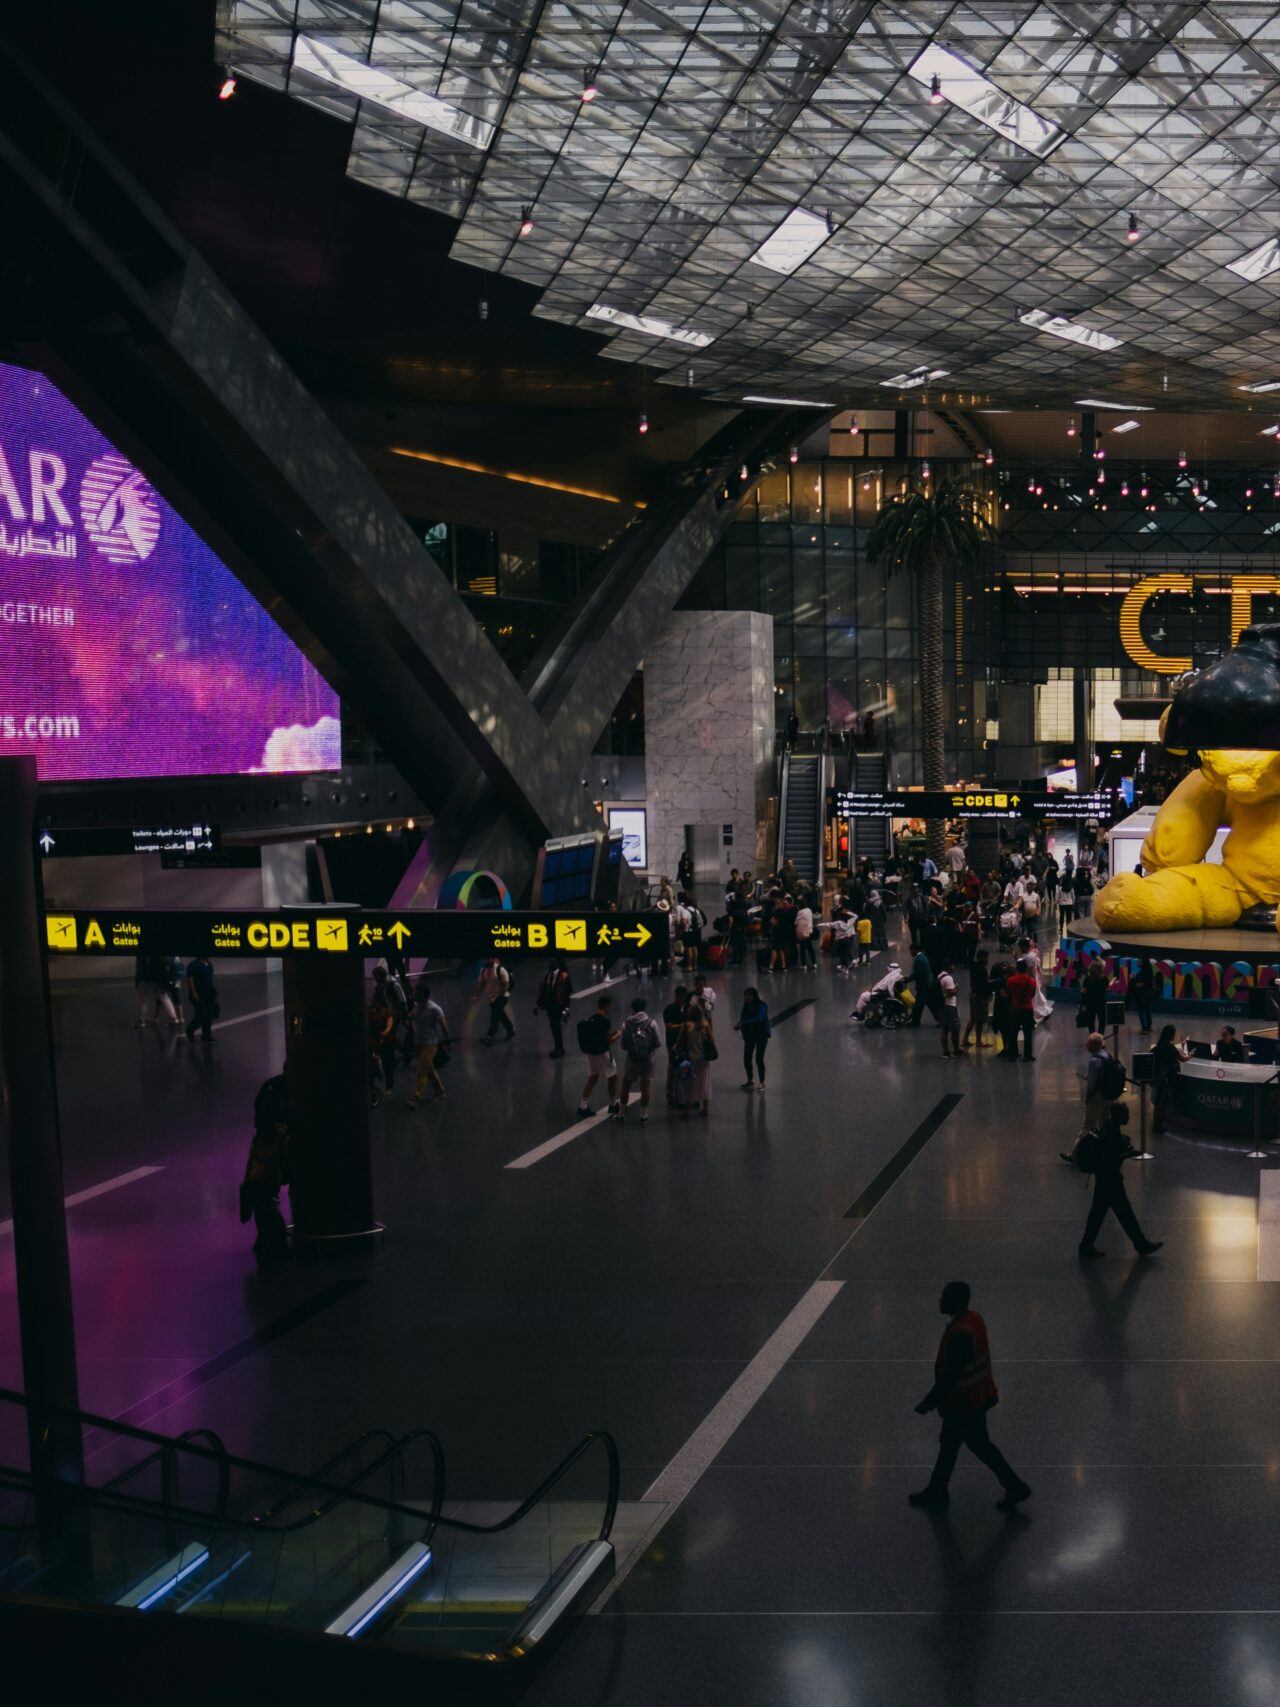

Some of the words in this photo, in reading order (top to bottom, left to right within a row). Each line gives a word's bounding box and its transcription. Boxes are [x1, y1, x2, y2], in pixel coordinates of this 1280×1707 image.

[0, 604, 74, 625] GETHER
[0, 714, 80, 737] s.com
[965, 795, 993, 807] CDE
[84, 919, 106, 946] A
[112, 921, 141, 935] بوابات
[211, 923, 240, 936] بوابات
[373, 927, 383, 936] 10
[491, 924, 521, 936] بوابات
[113, 937, 139, 946] Gates
[247, 922, 310, 948] CDE
[527, 923, 549, 948] B
[214, 938, 240, 947] Gates
[494, 939, 521, 948] Gates
